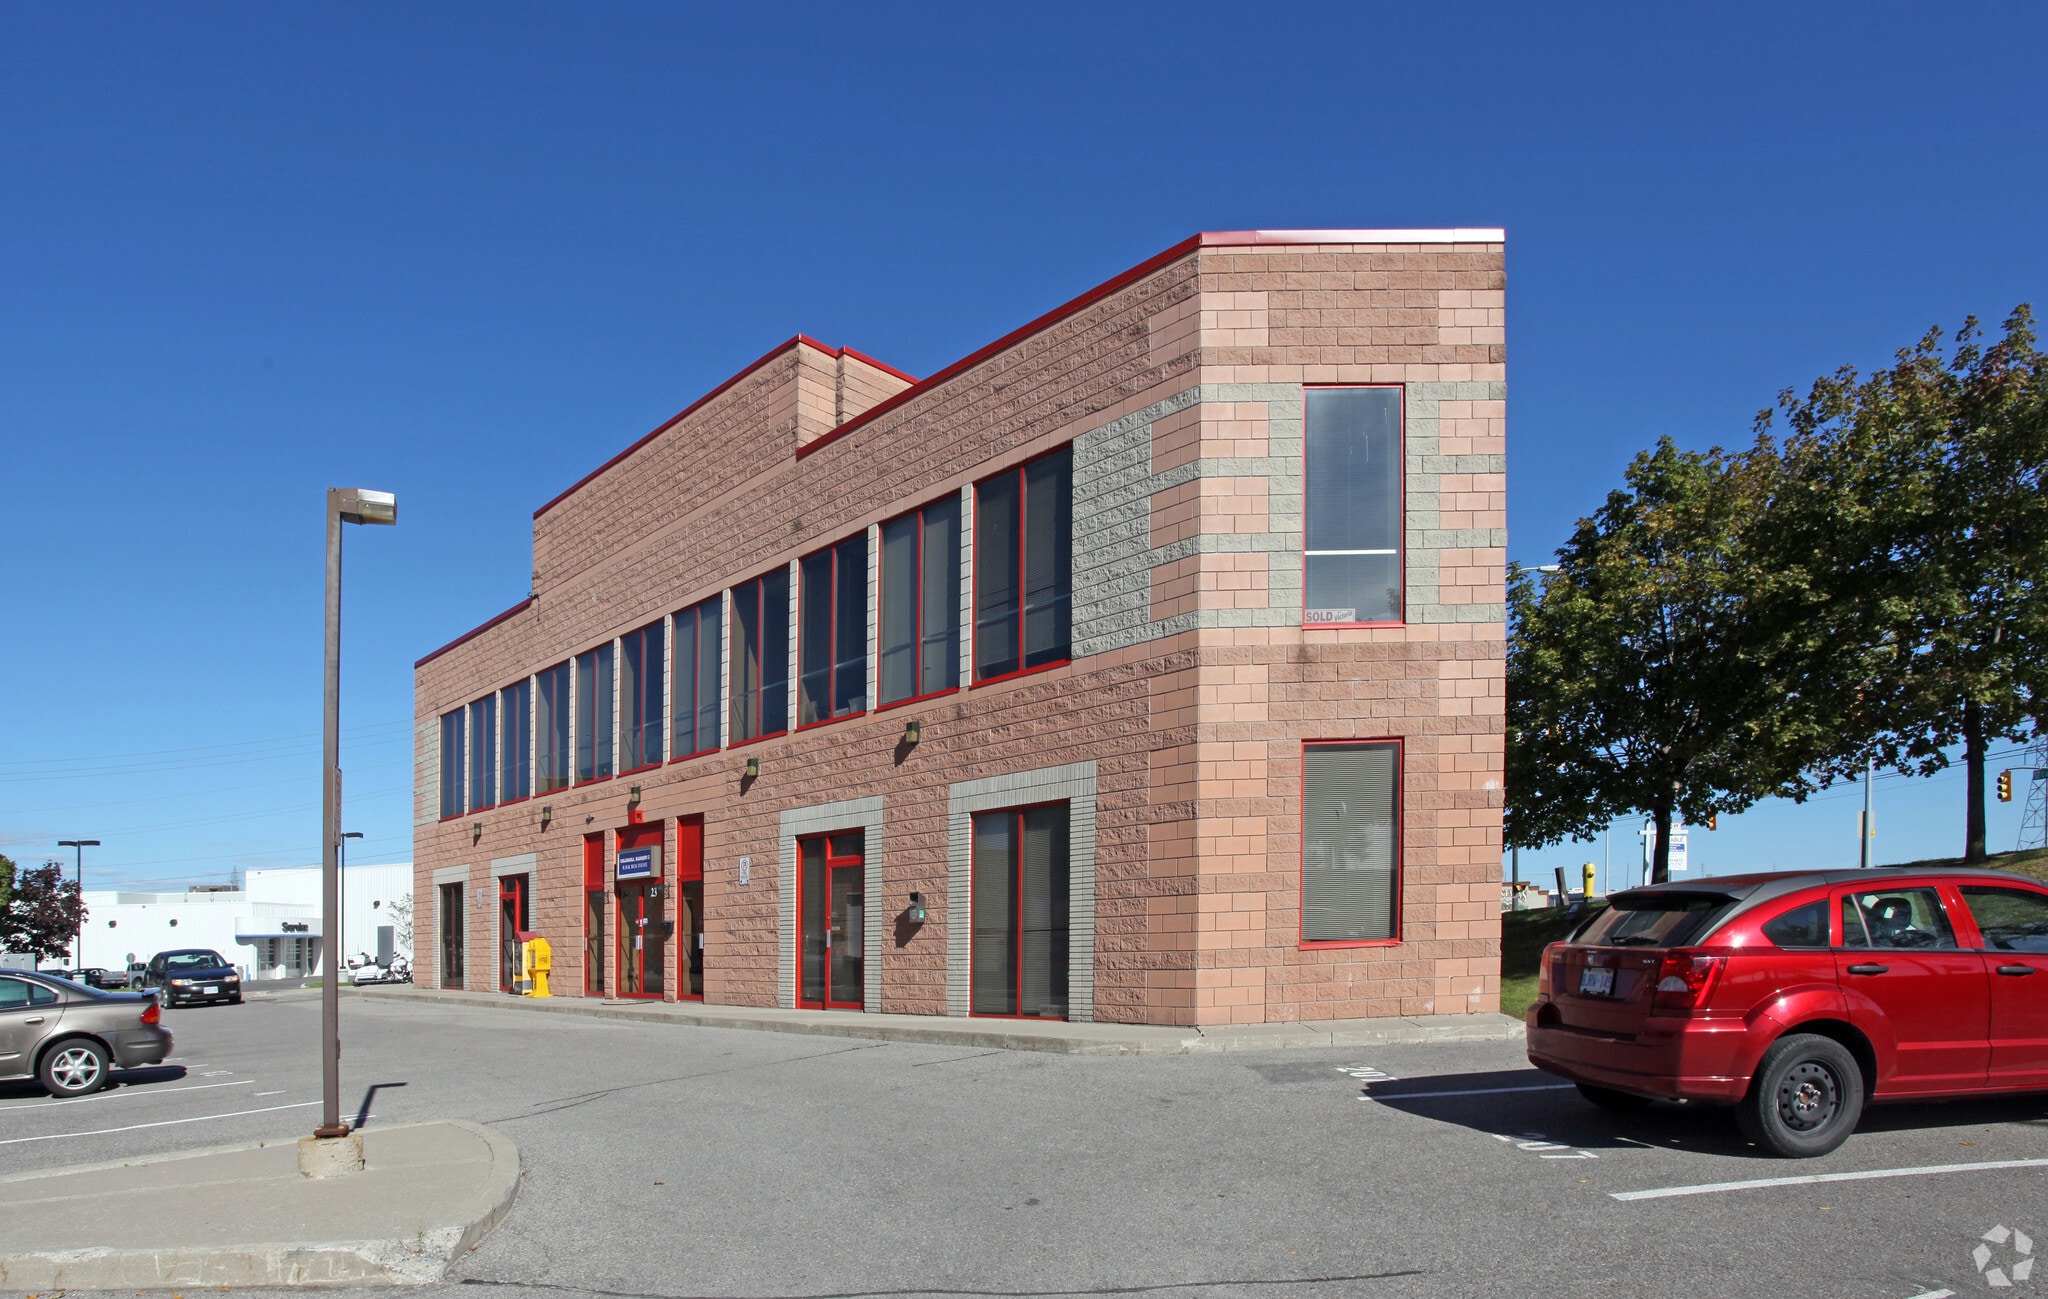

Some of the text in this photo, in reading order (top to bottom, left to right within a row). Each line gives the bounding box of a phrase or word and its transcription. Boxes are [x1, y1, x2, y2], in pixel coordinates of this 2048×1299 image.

[1306, 611, 1333, 622] SOLD
[651, 887, 658, 897] 23
[281, 922, 309, 933] Service
